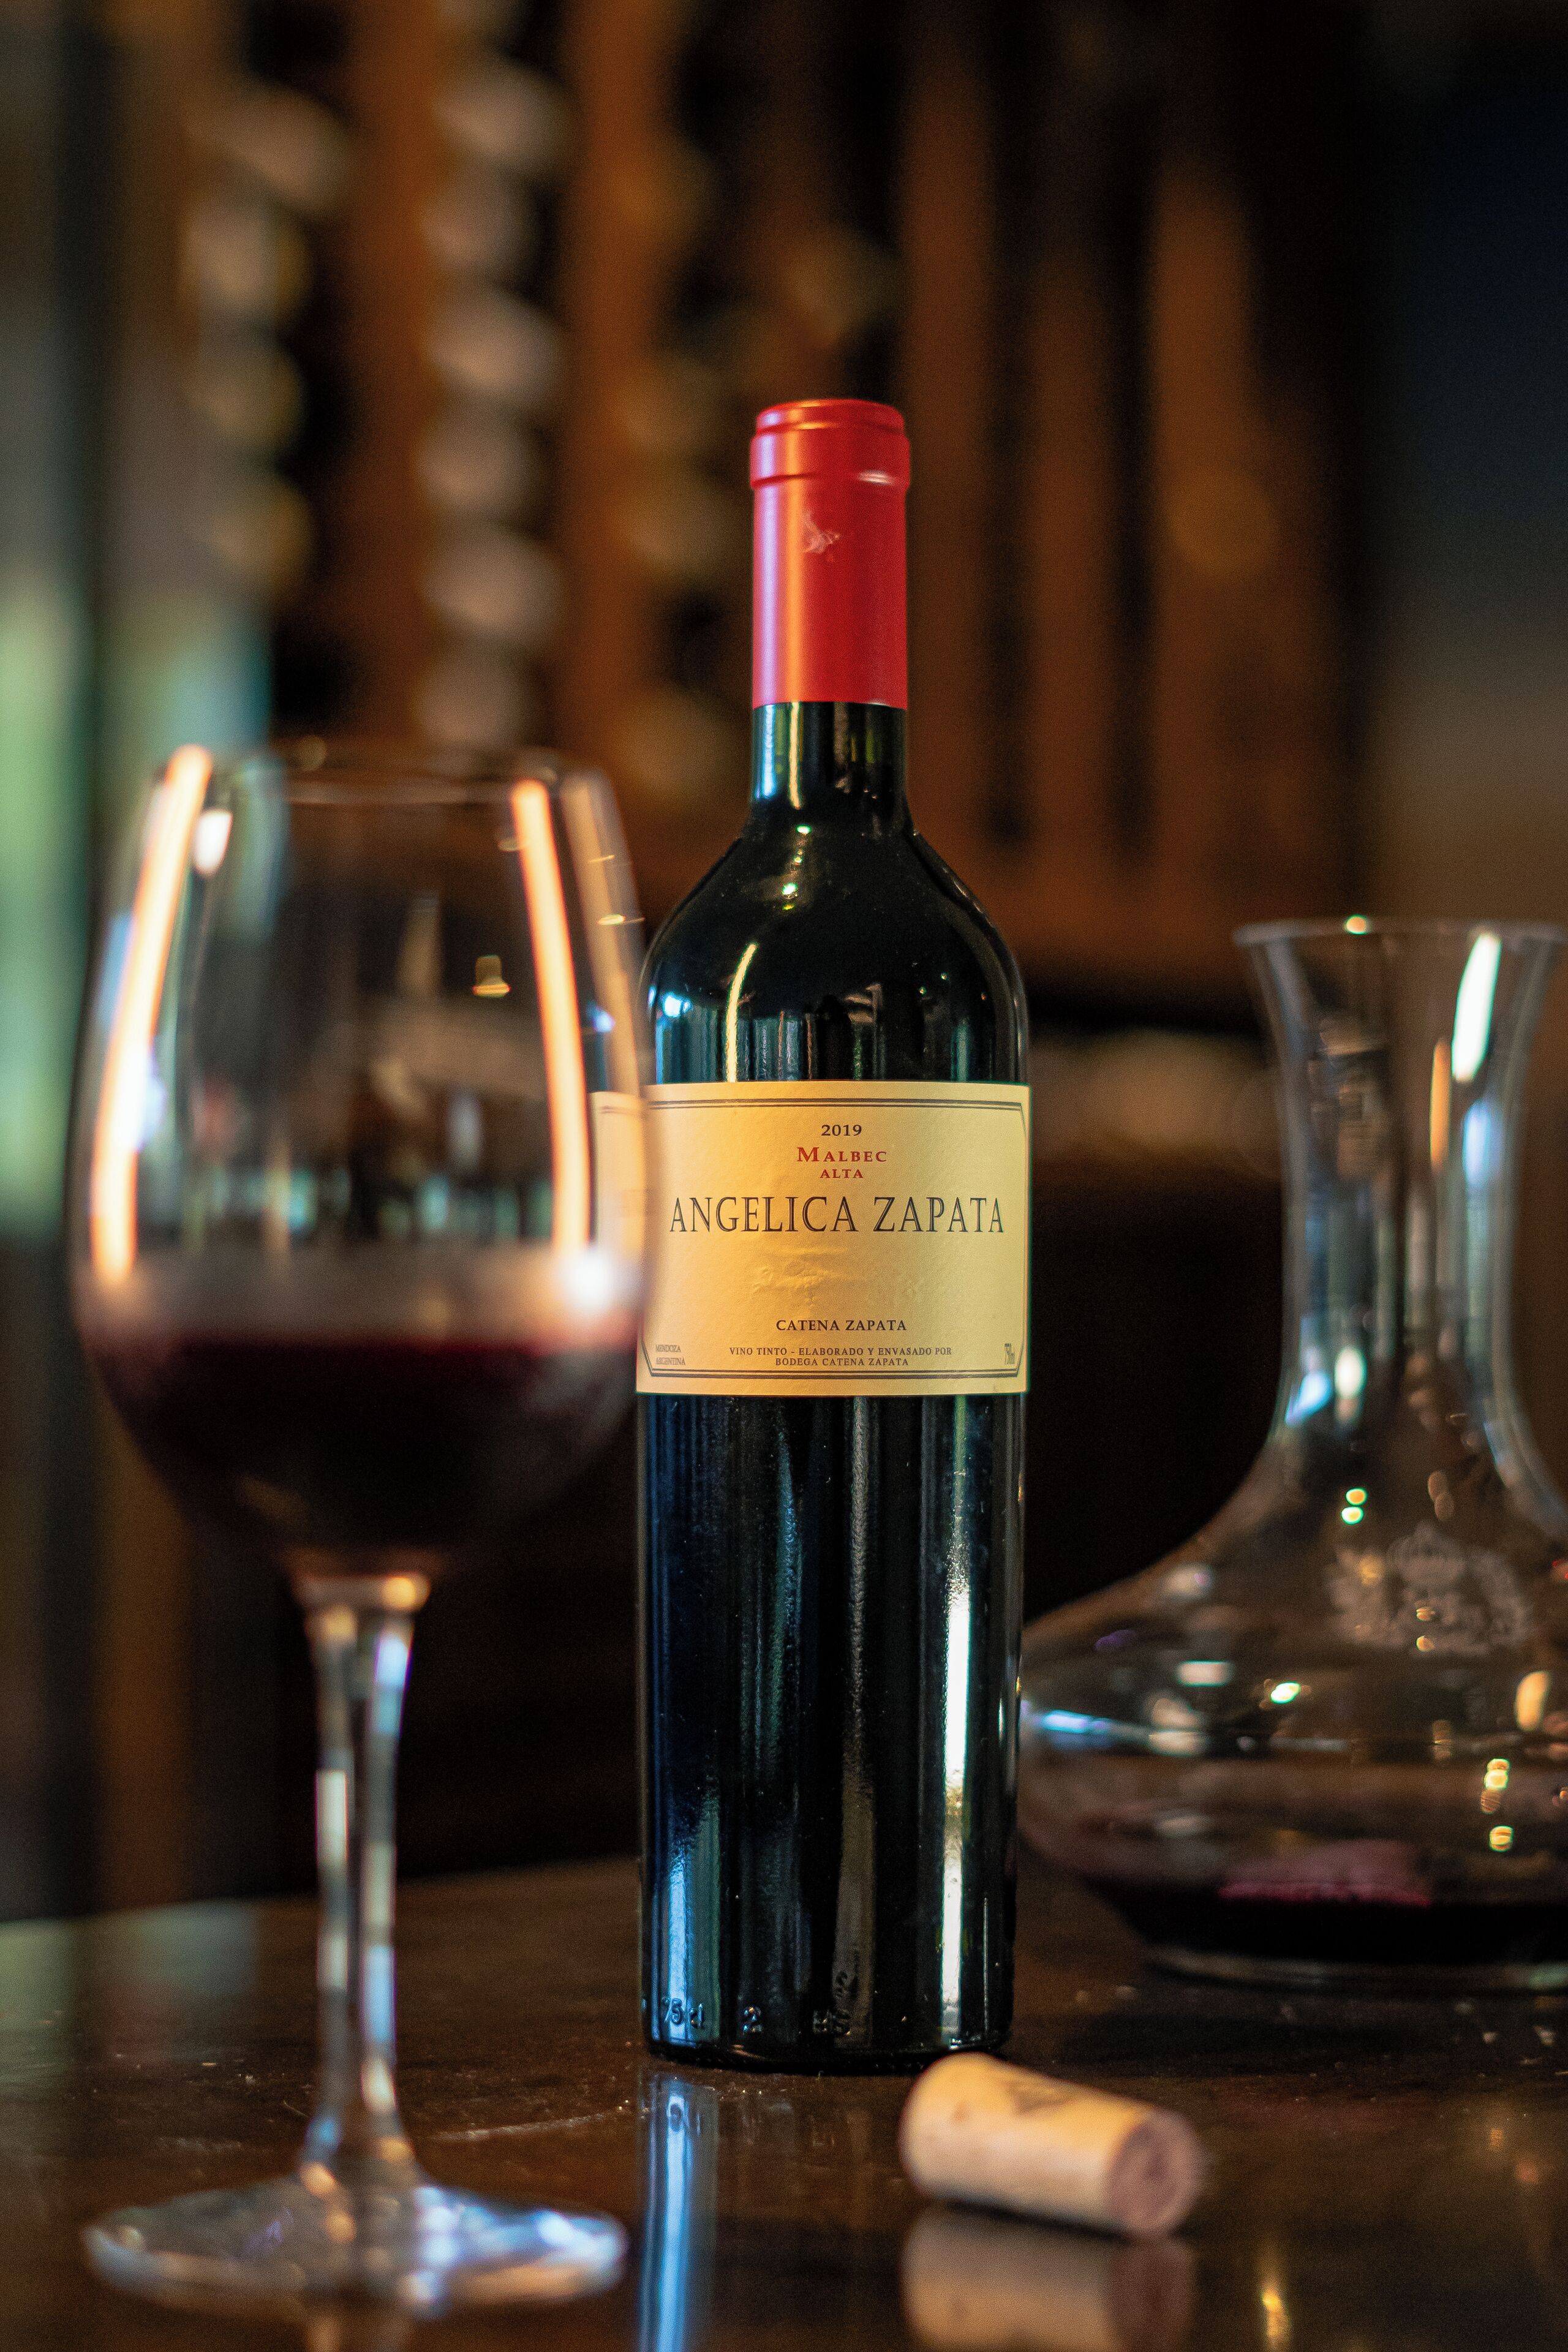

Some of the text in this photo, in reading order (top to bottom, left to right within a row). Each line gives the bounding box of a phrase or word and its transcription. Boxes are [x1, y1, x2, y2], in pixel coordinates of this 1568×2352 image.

[821, 1124, 862, 1136] 2019
[820, 1169, 864, 1178] ALTA
[669, 1196, 1005, 1234] ANGELICA ZAPATA
[776, 1320, 907, 1332] CATENA ZAPATA
[655, 1344, 682, 1353] MENDOZA
[656, 1357, 686, 1366] ARGENTINA
[775, 1358, 818, 1366] BODEGA
